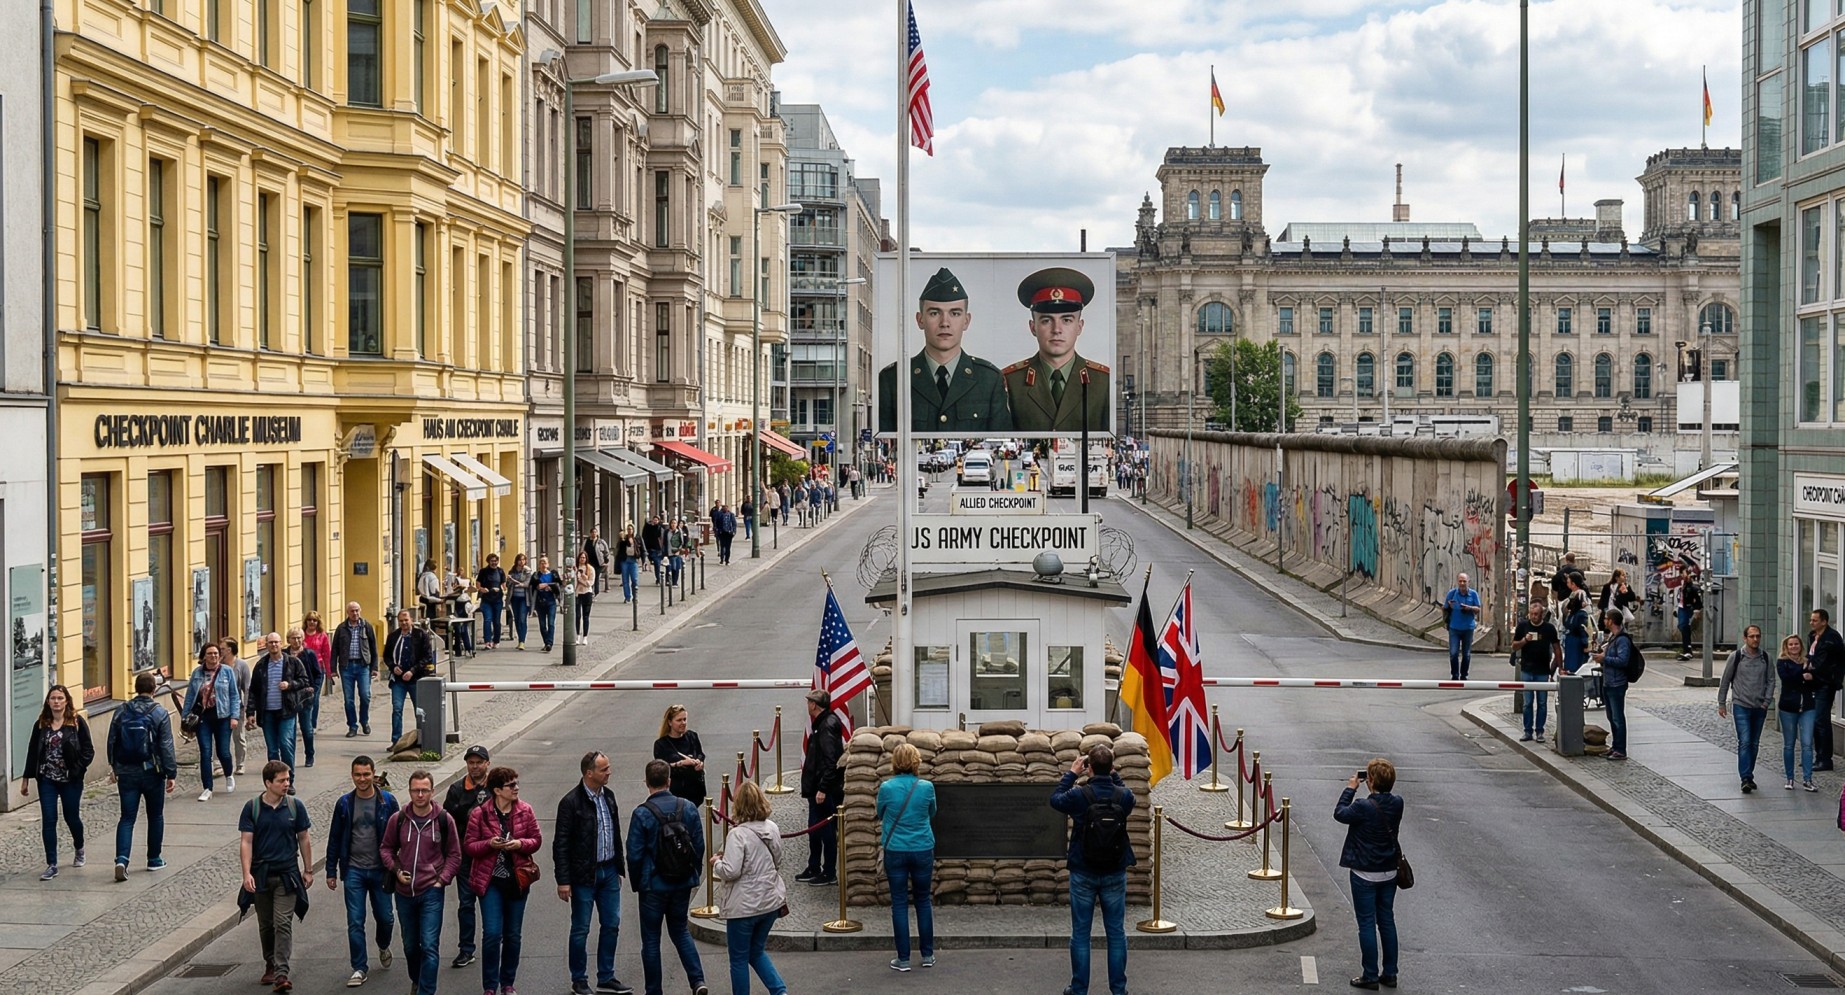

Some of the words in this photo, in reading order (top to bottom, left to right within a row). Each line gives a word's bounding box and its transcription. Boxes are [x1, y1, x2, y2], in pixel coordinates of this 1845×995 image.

[95, 414, 192, 448] CHECKPOINT
[195, 415, 250, 446] CHARLIE
[252, 415, 301, 445] MUSEUM
[959, 497, 986, 509] ALLIED
[988, 497, 1037, 509] CHECKPOINT
[938, 526, 983, 549] ARMY
[990, 526, 1087, 549] CHECKPOINT
